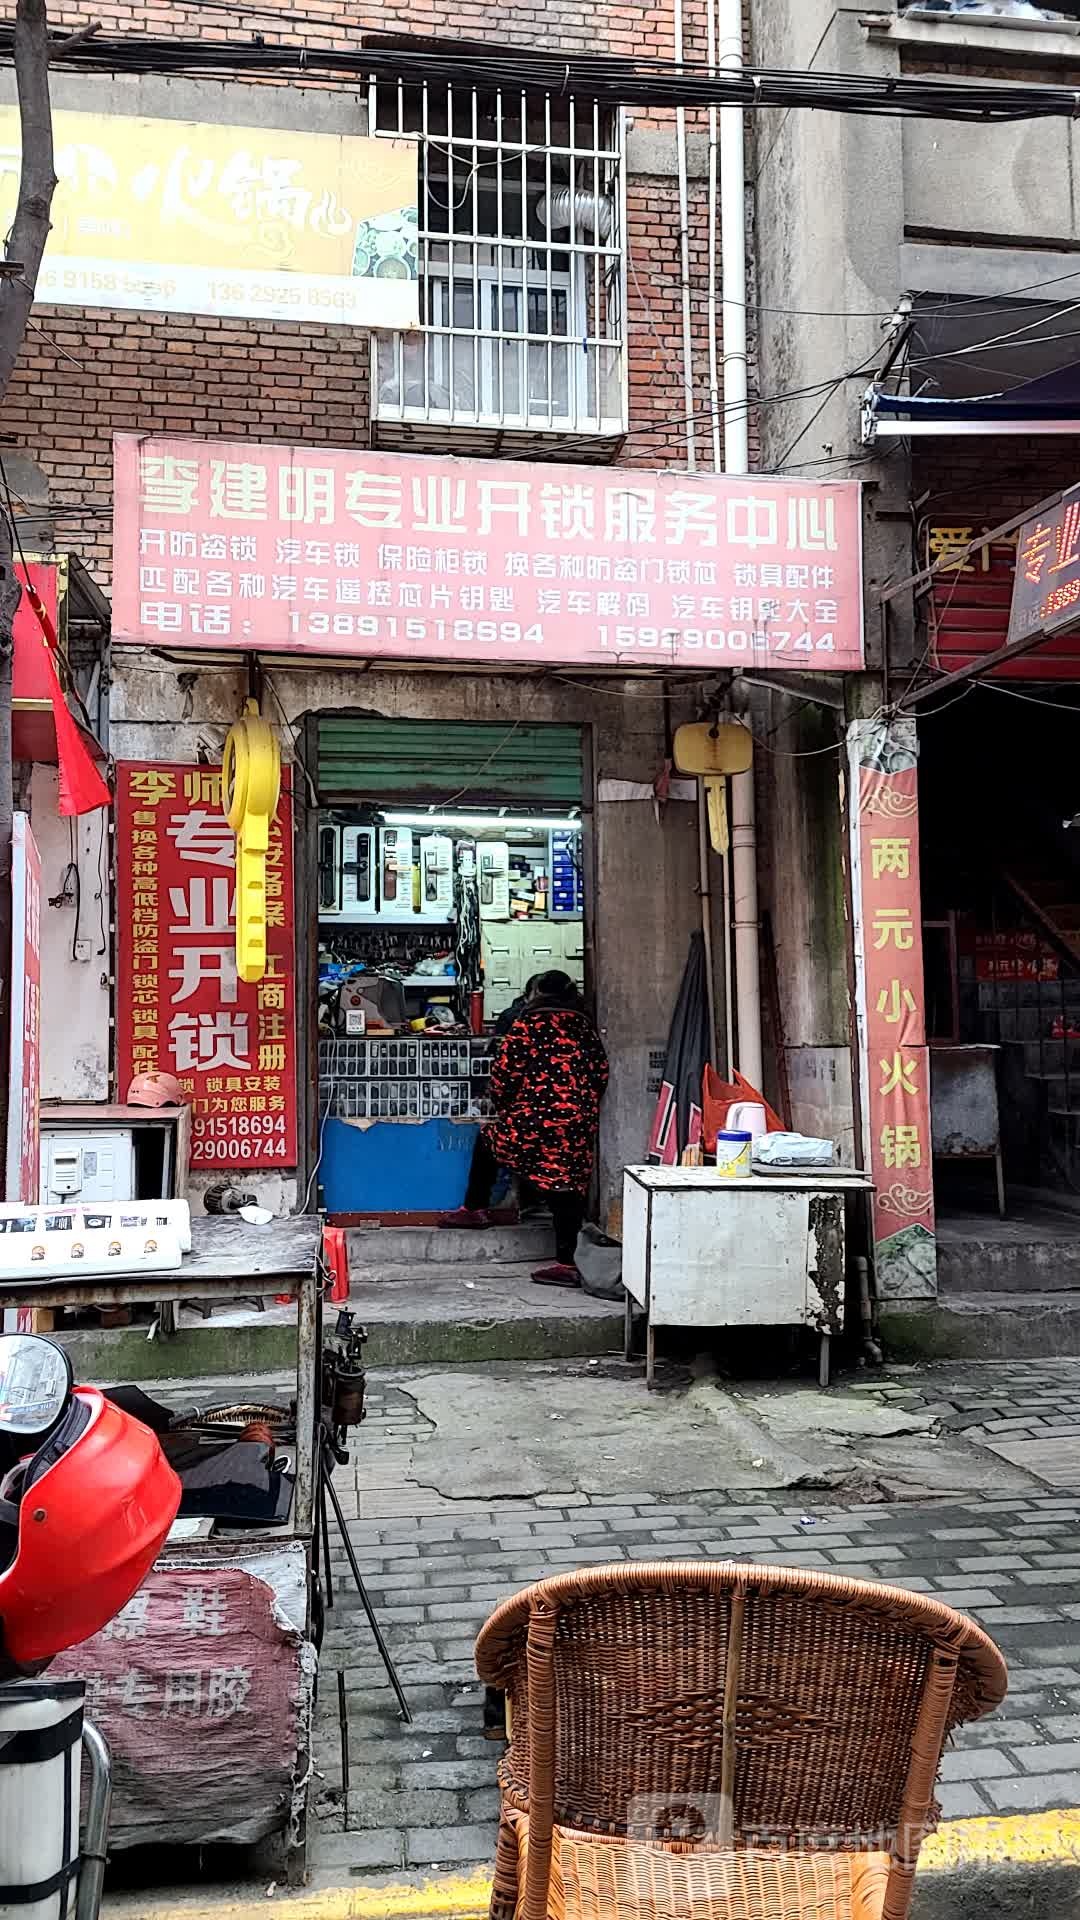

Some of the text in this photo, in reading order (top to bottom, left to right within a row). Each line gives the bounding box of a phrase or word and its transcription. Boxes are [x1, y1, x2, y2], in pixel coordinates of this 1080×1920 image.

[139, 455, 838, 551] 李建明专业开锁服务中心
[139, 528, 257, 563] 开防盗锁
[275, 536, 360, 569] 汽车锁
[378, 542, 488, 577] 保险柜锁
[733, 562, 834, 591] 锁具配件
[139, 567, 838, 624] 匹配各种汽车遥控芯片钥匙 汽车解码 汽车钥匙大全
[289, 612, 544, 645] 13891518694
[598, 625, 836, 653] 15929006744
[129, 770, 222, 806] 李师
[166, 810, 252, 1072] 专业开锁
[869, 836, 923, 1170] 两元小火锅
[192, 1095, 286, 1113] 门为您服务
[206, 1076, 281, 1093] 锁具安装
[192, 1115, 286, 1137] 91518694
[192, 1138, 287, 1160] 29006744
